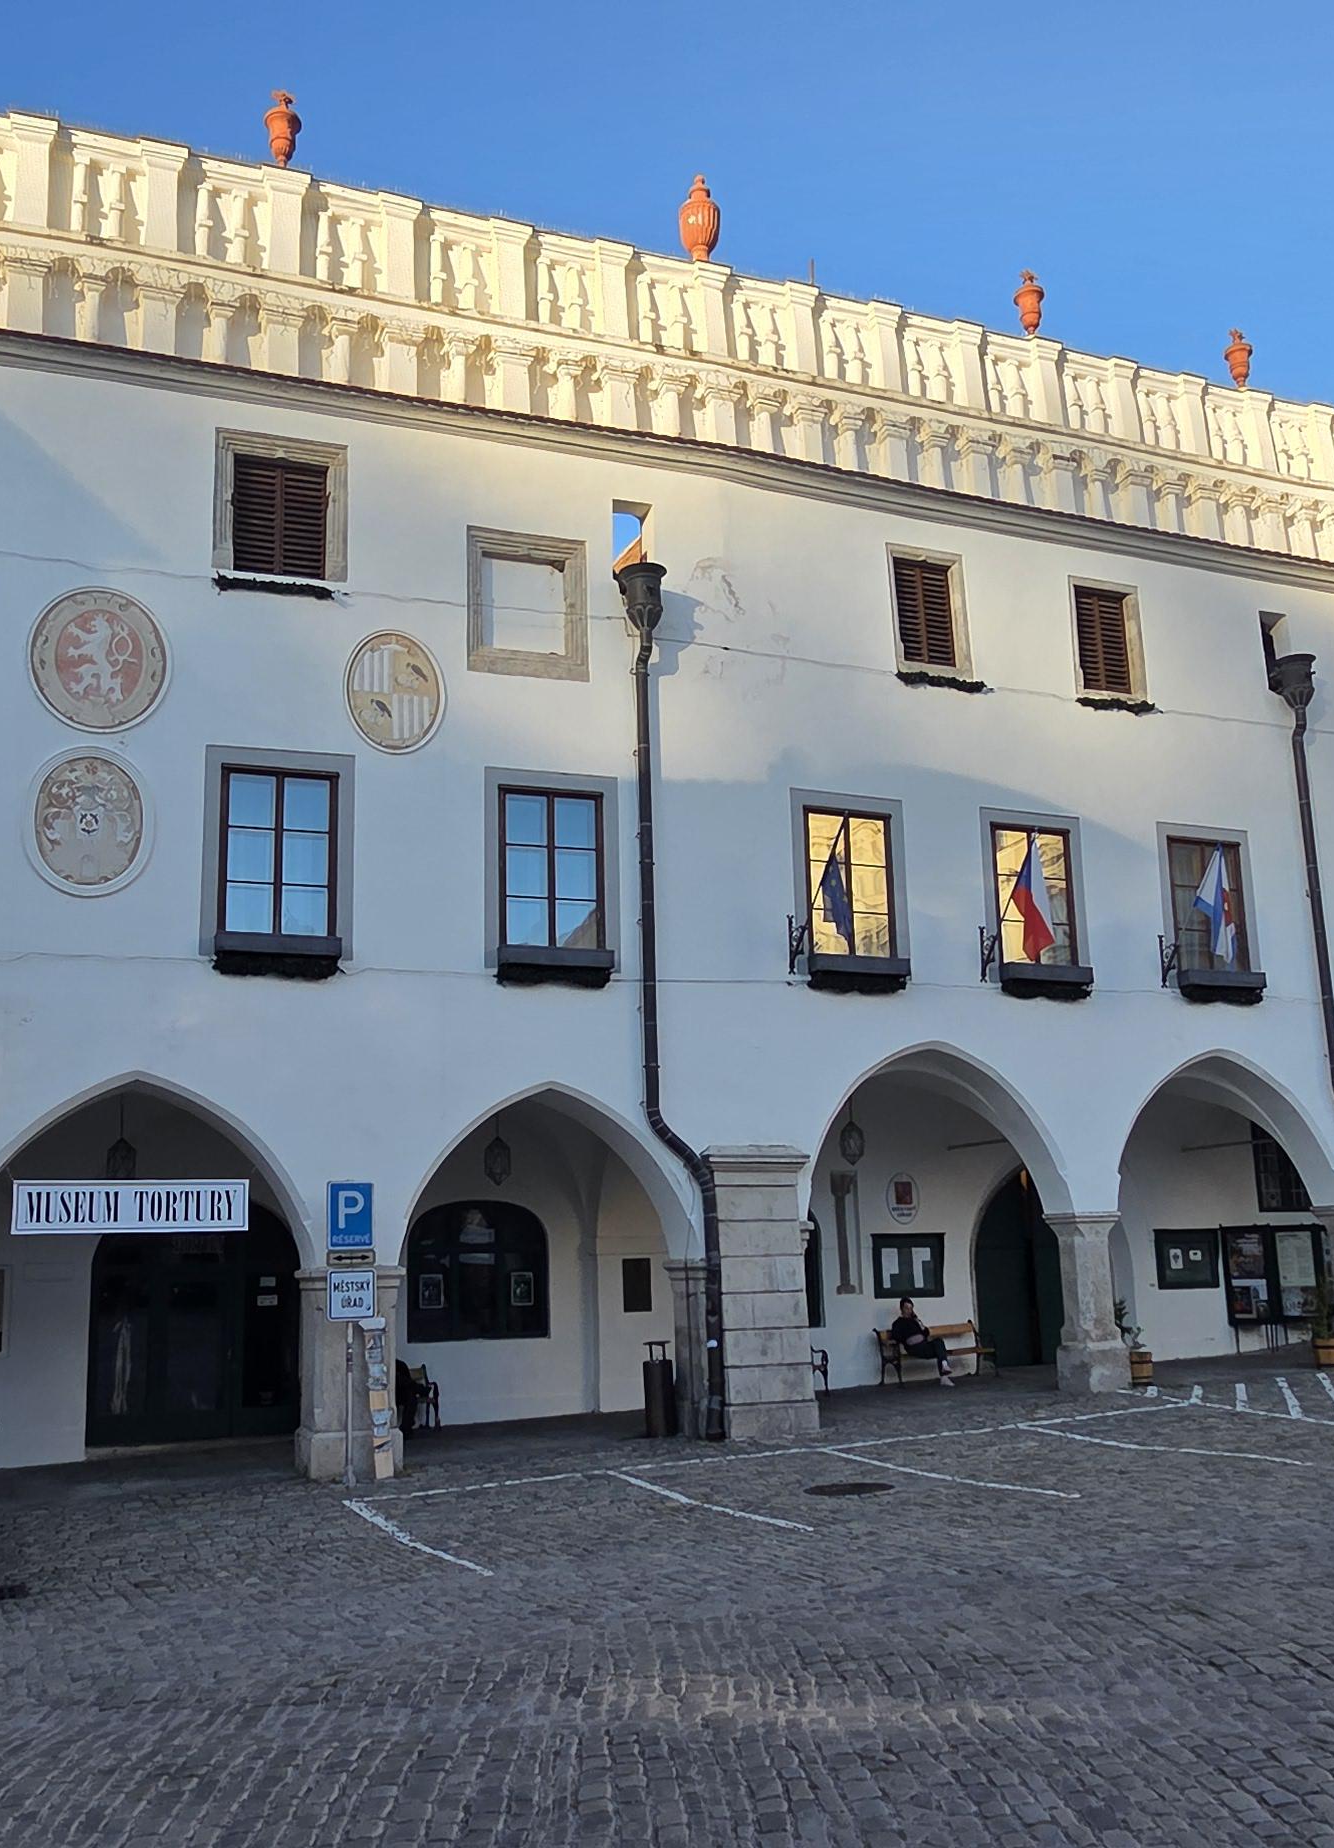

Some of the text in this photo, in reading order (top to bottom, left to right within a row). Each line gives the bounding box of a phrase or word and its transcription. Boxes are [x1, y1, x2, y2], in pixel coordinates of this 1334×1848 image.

[25, 1189, 238, 1224] MUSEUM TORTURY
[338, 1190, 365, 1229] P
[333, 1279, 371, 1293] MĚSTSKÝ
